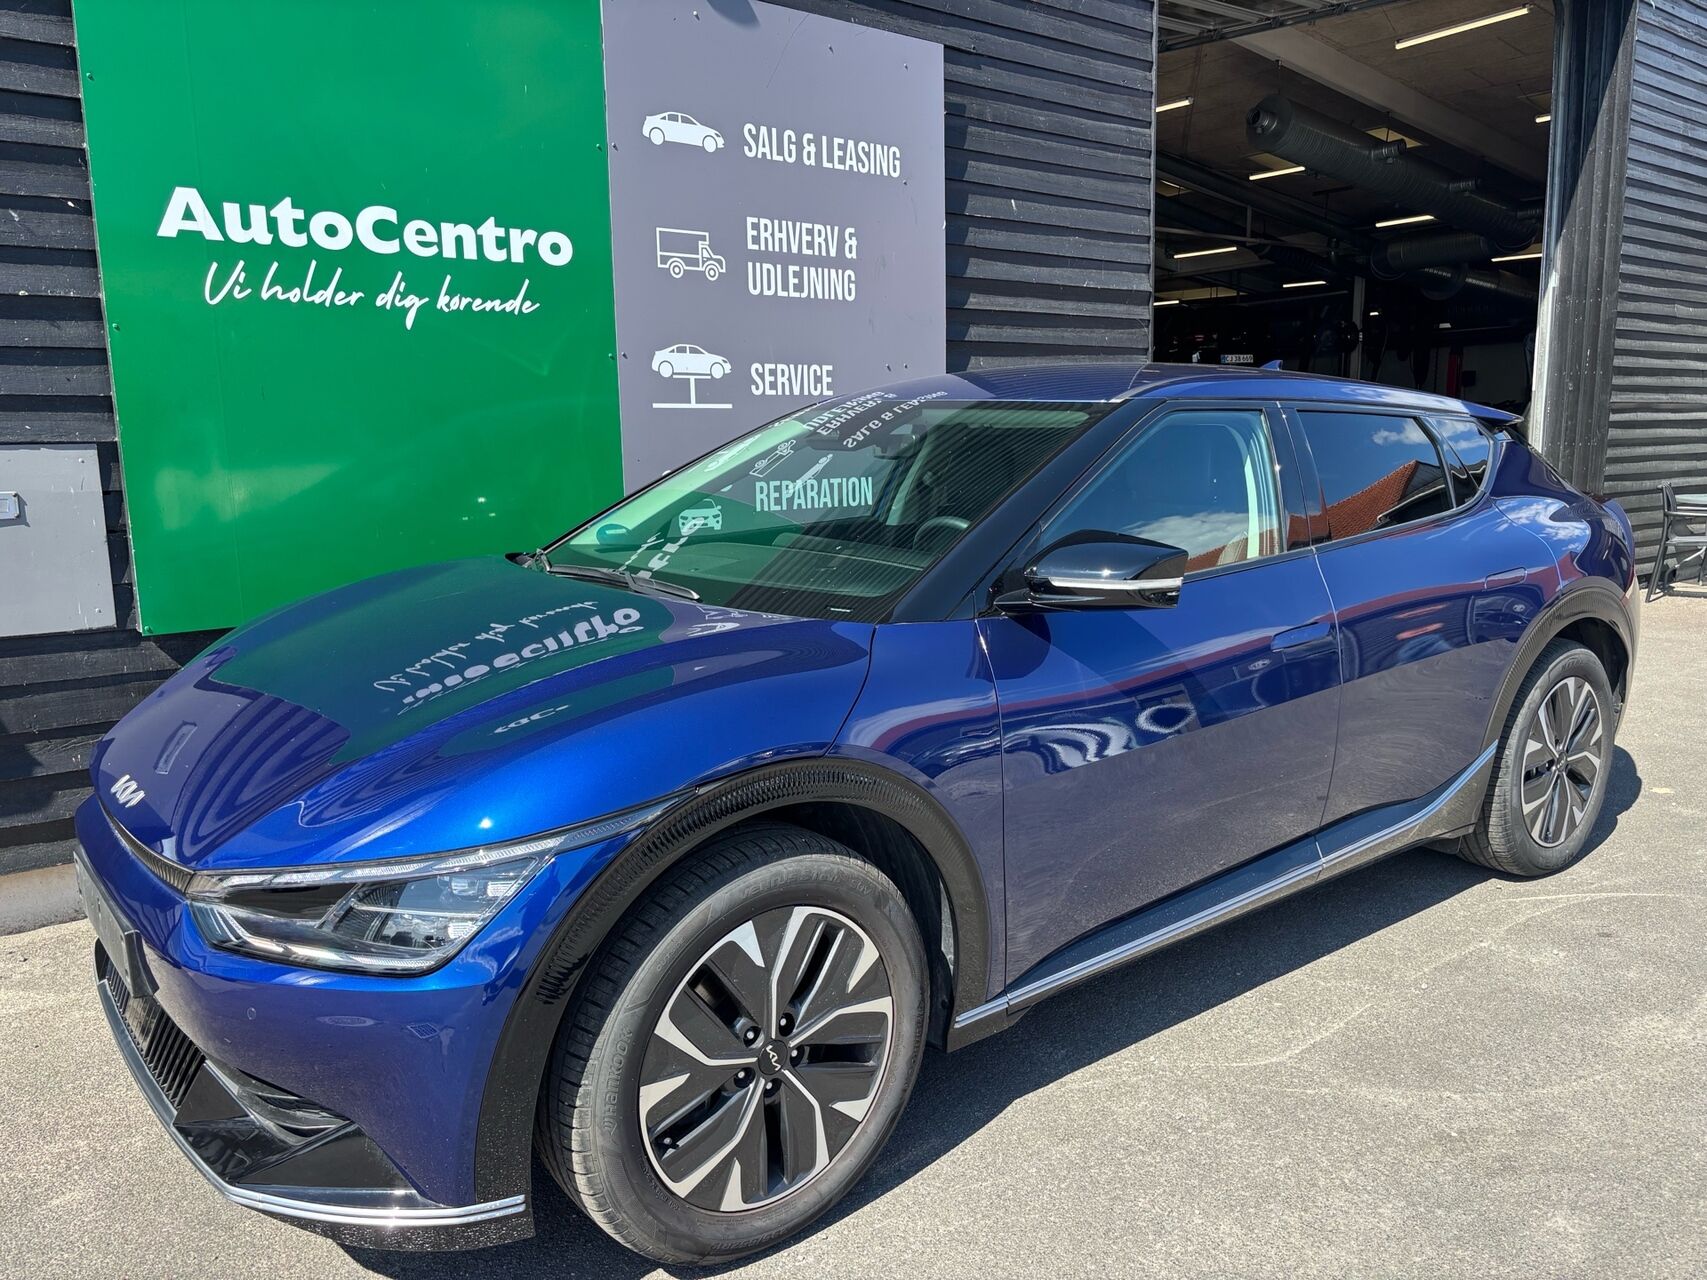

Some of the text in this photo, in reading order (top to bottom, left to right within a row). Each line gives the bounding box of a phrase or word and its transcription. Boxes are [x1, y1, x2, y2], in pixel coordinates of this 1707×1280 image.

[743, 123, 901, 179] SALG & LEASING
[156, 186, 574, 266] AutoCentro
[746, 216, 858, 260] ERHVERV &
[204, 259, 541, 331] Vi holder dig kørende
[747, 261, 857, 302] UDLEJNING
[750, 362, 834, 397] SERVICE
[755, 476, 873, 512] REPARATION
